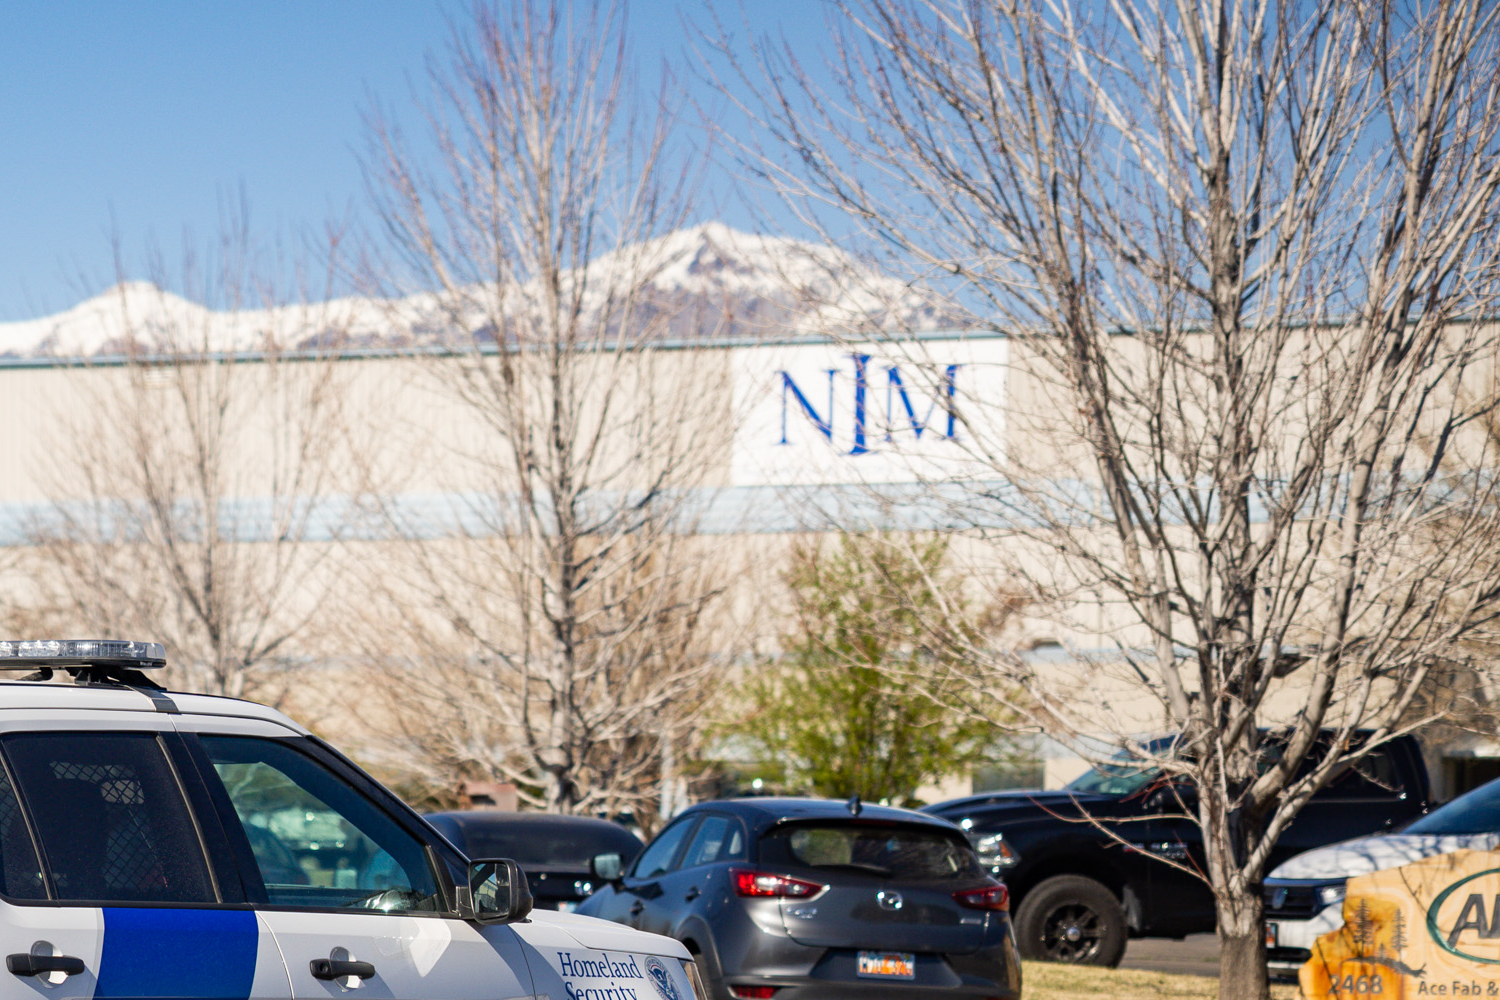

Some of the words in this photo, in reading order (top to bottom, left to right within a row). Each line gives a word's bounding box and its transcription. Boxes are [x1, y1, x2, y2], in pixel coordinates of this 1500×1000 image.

[557, 951, 644, 979] Homeland
[1328, 974, 1383, 994] 2468
[1418, 980, 1447, 996] Ace
[1452, 979, 1482, 996] Fab
[1486, 980, 1499, 997] &
